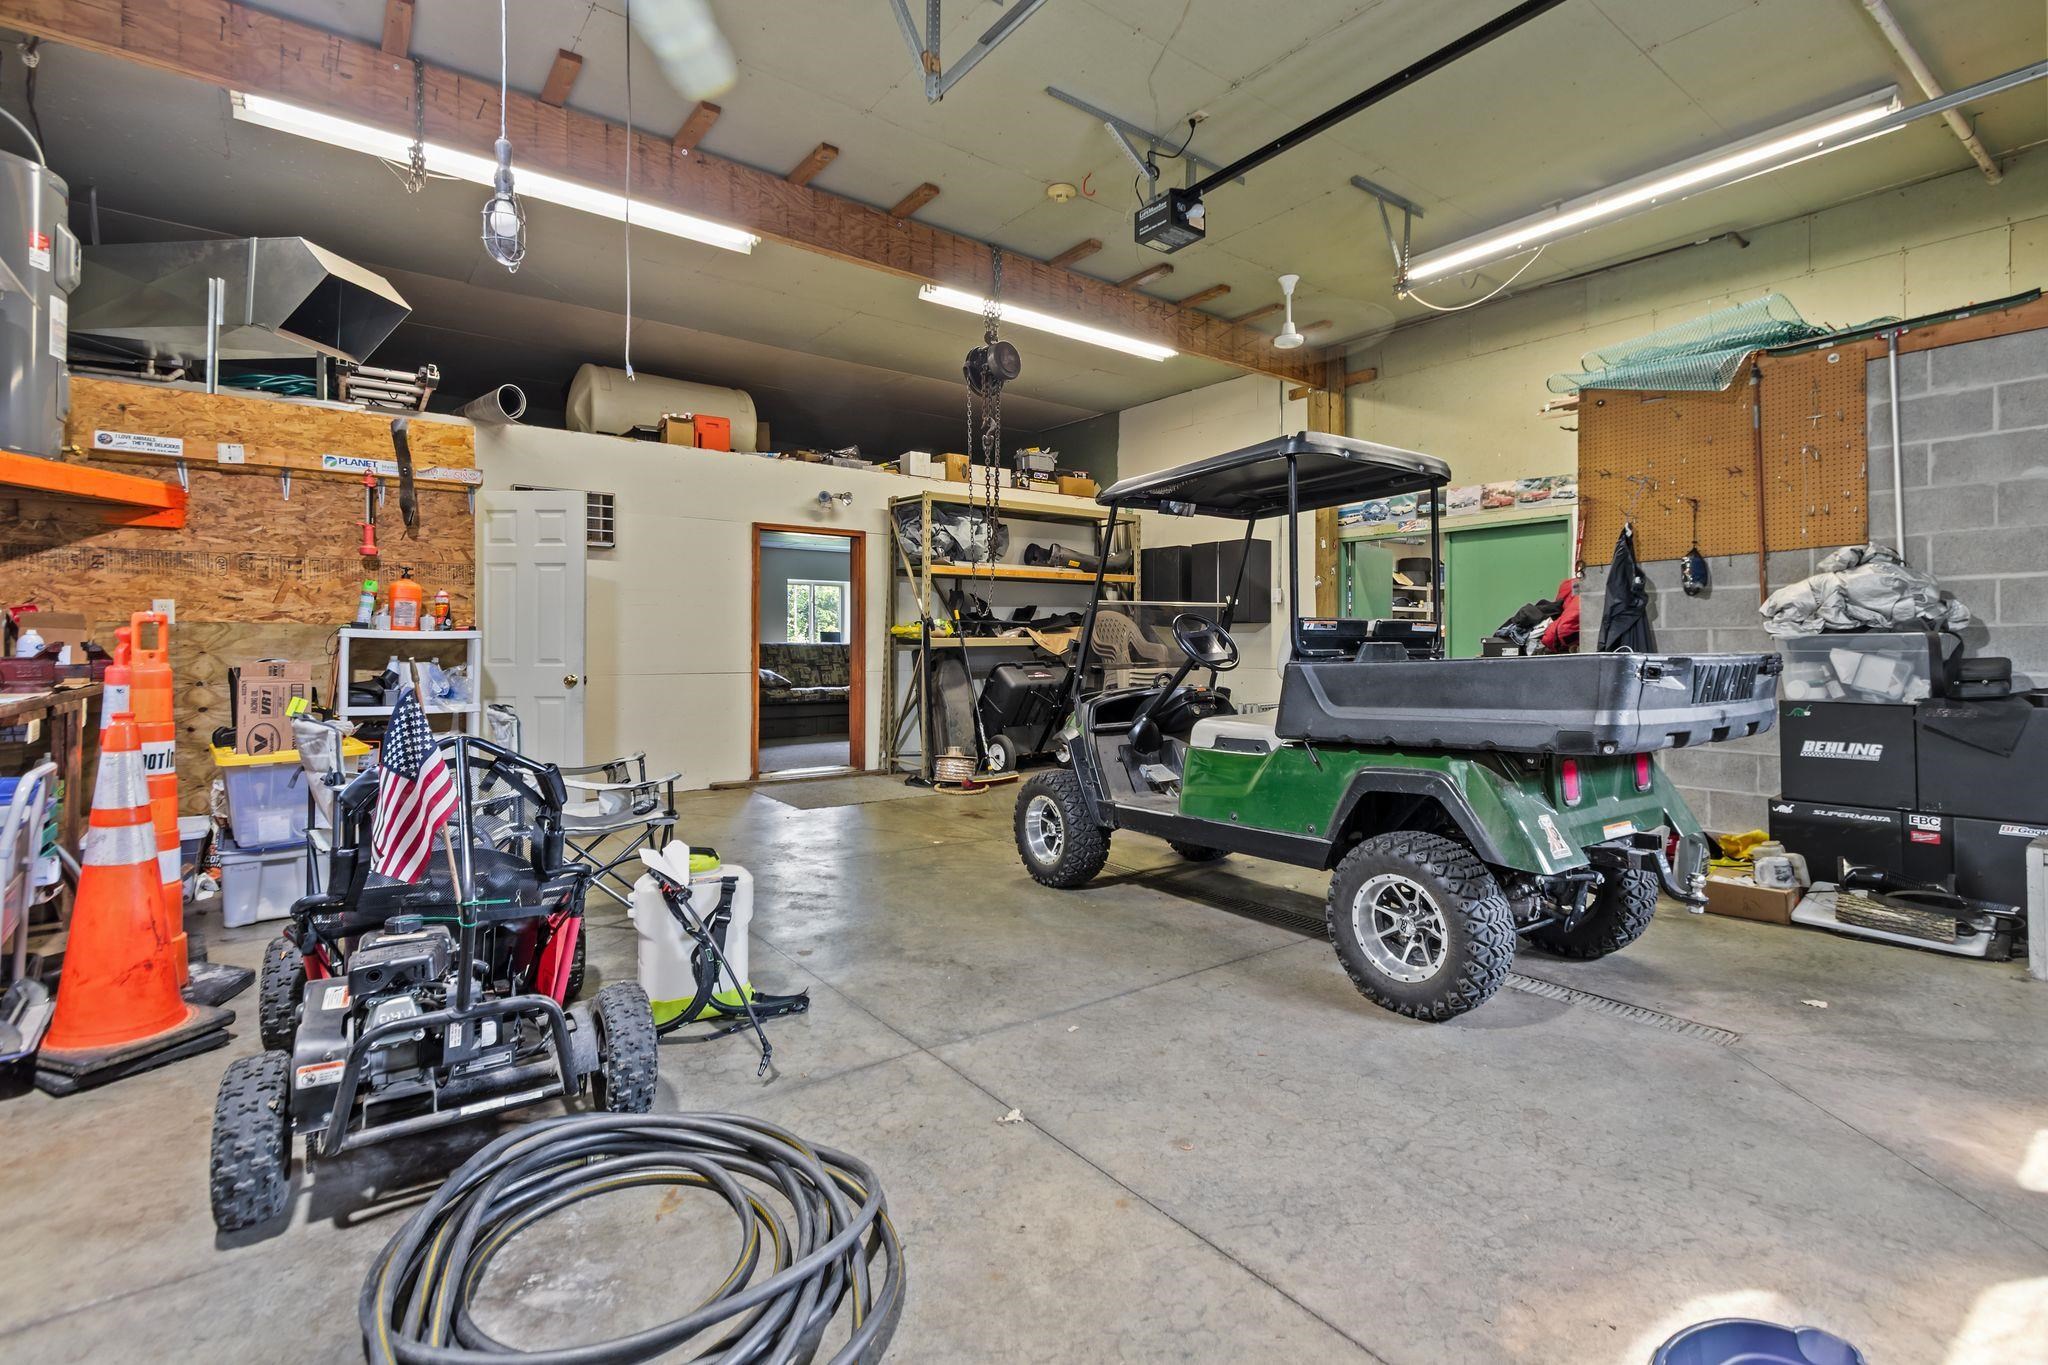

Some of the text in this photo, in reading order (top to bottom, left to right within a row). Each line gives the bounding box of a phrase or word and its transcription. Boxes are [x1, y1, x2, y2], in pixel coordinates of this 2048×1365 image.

[338, 457, 378, 468] PLANET
[261, 689, 272, 715] VR1
[1801, 740, 1883, 756] BEHLING
[1910, 814, 1941, 827] EBC
